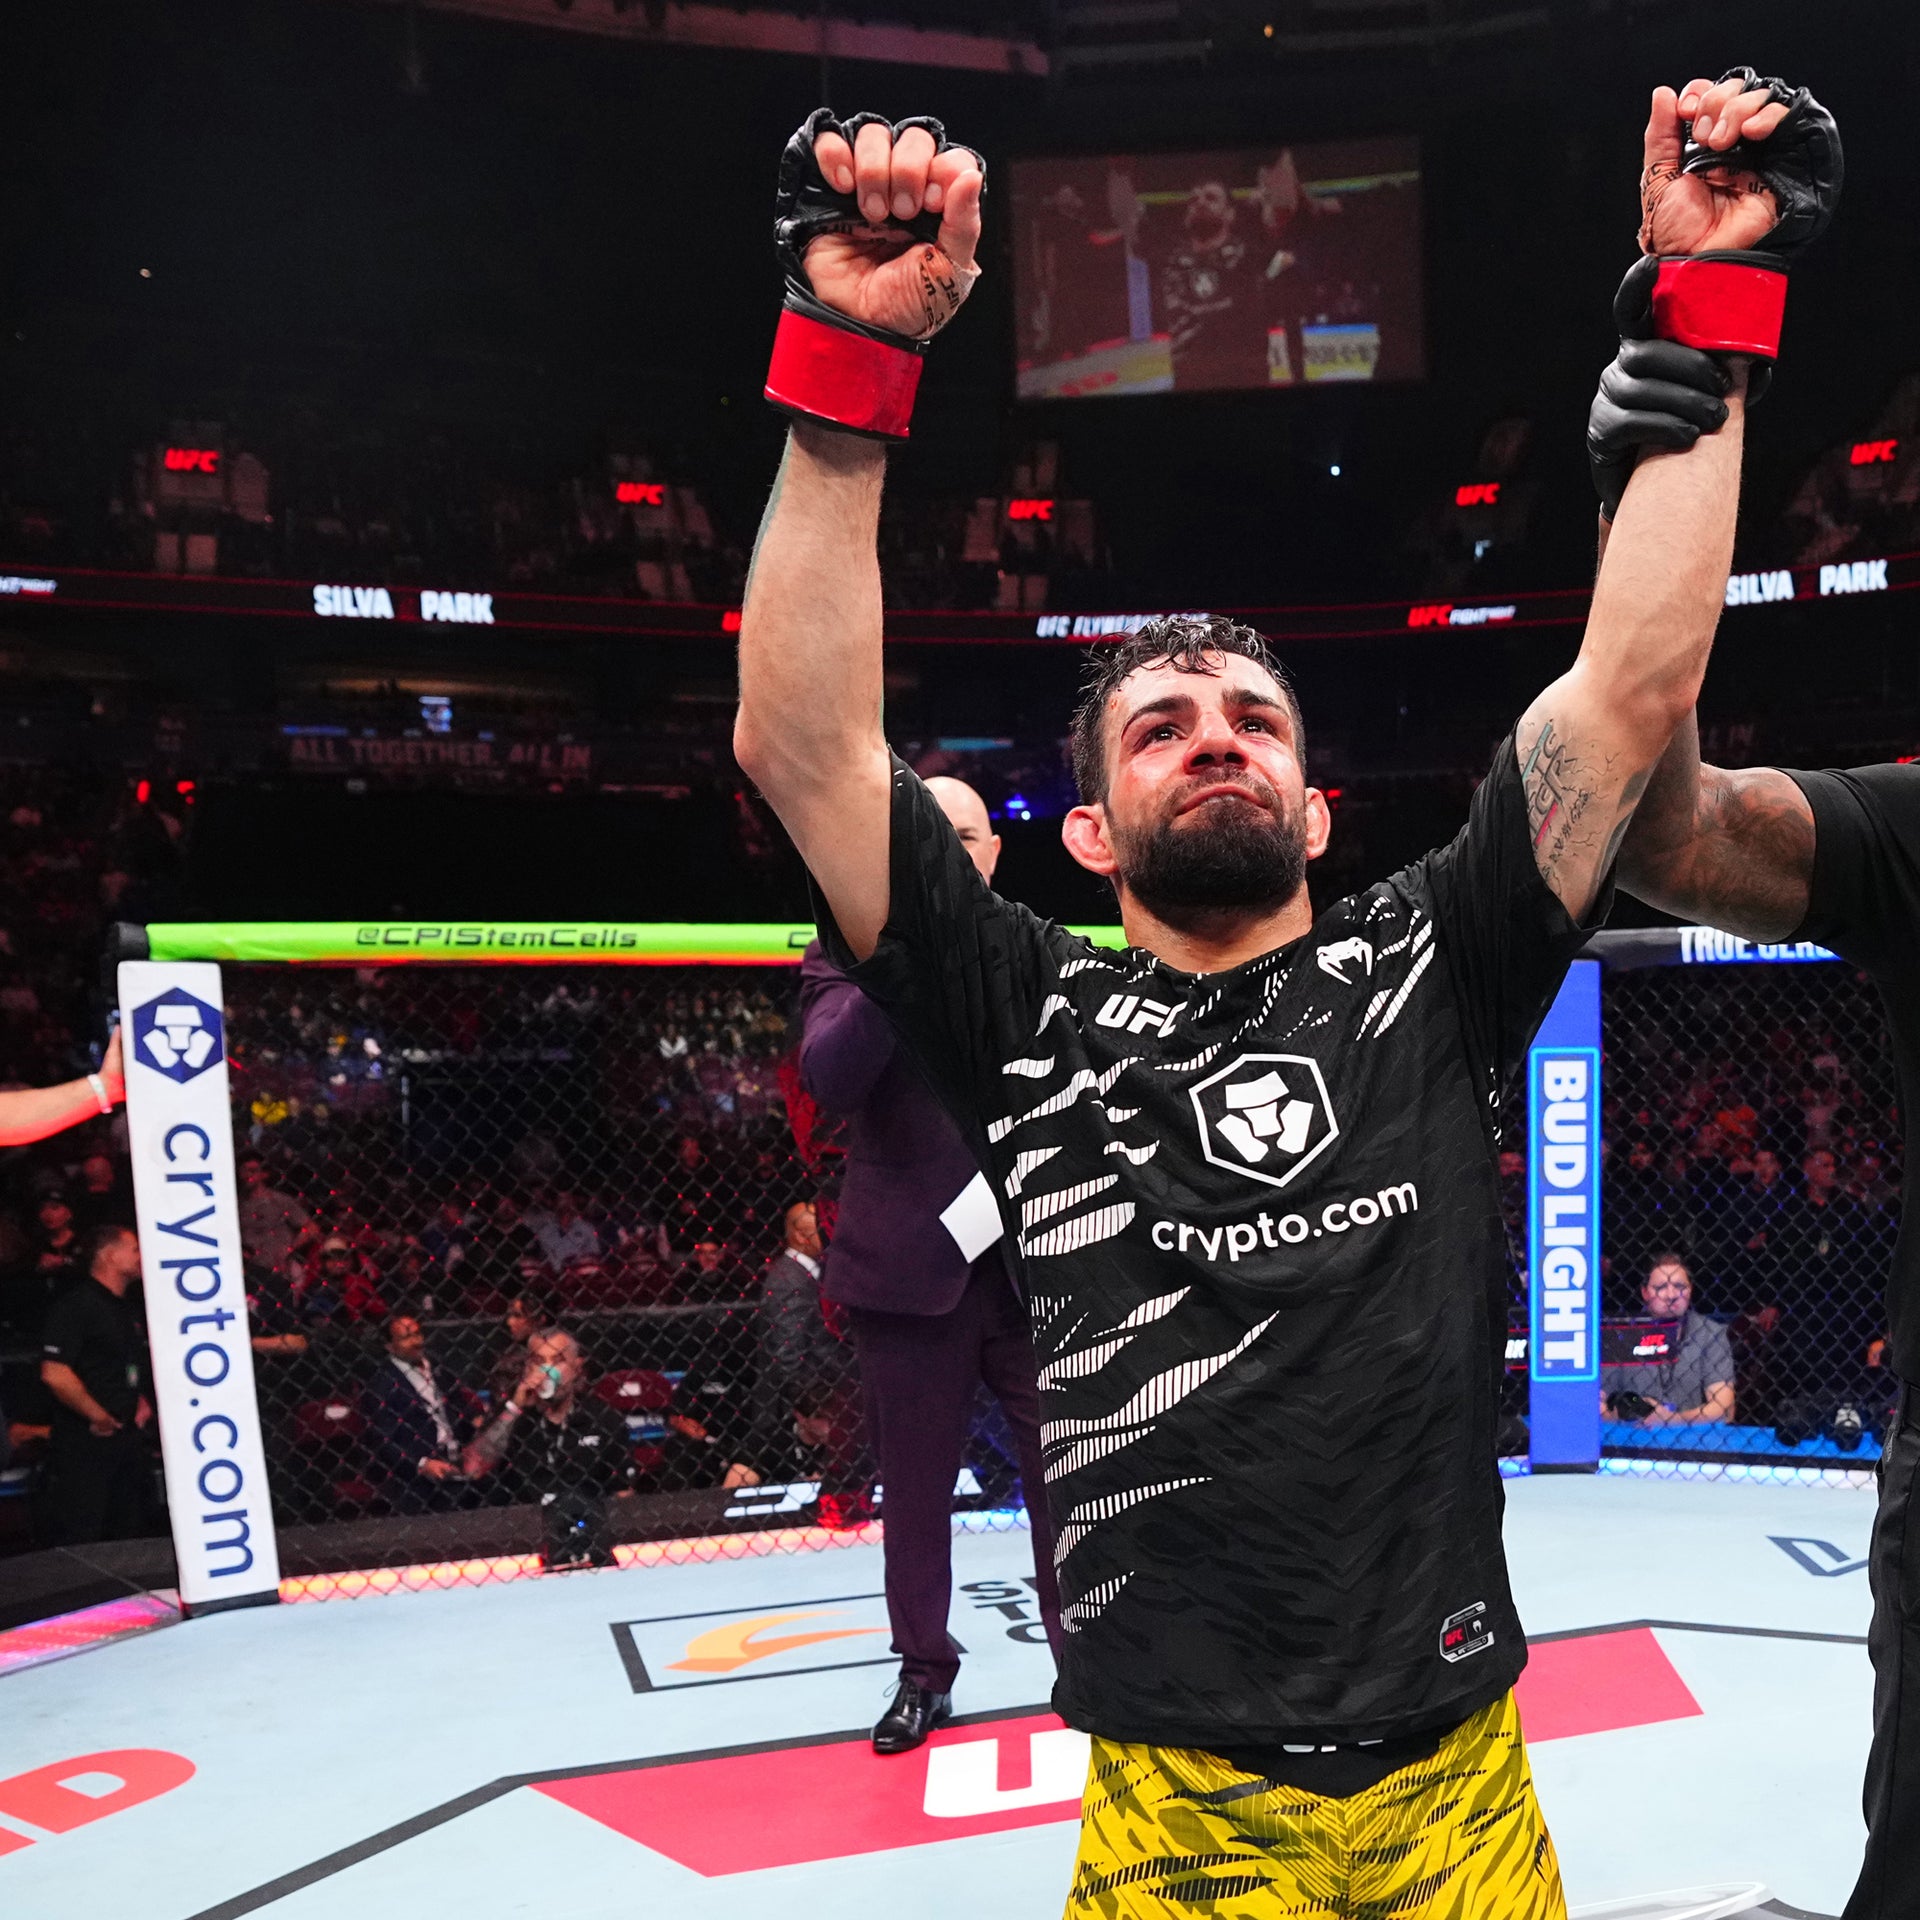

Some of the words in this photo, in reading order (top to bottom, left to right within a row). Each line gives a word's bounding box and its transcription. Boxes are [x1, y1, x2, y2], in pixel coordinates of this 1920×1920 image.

[164, 448, 220, 473] UFC
[1851, 439, 1898, 465] UFC
[615, 482, 665, 505] UFC
[1455, 483, 1500, 507] UFC
[1008, 499, 1055, 521] UFC
[1725, 569, 1795, 606] SILVA
[1820, 559, 1888, 596] PARK
[313, 584, 395, 619] SILVA
[420, 590, 495, 624] PARK
[1407, 604, 1453, 627] UFC
[1036, 615, 1071, 638] UFC
[356, 927, 638, 948] @CPIStemCells
[1095, 993, 1188, 1038] UFC
[1542, 1060, 1588, 1189] BUD
[1151, 1182, 1418, 1262] crypto.com
[1542, 1195, 1588, 1370] LIGHT
[156, 1122, 254, 1579] crypto.com
